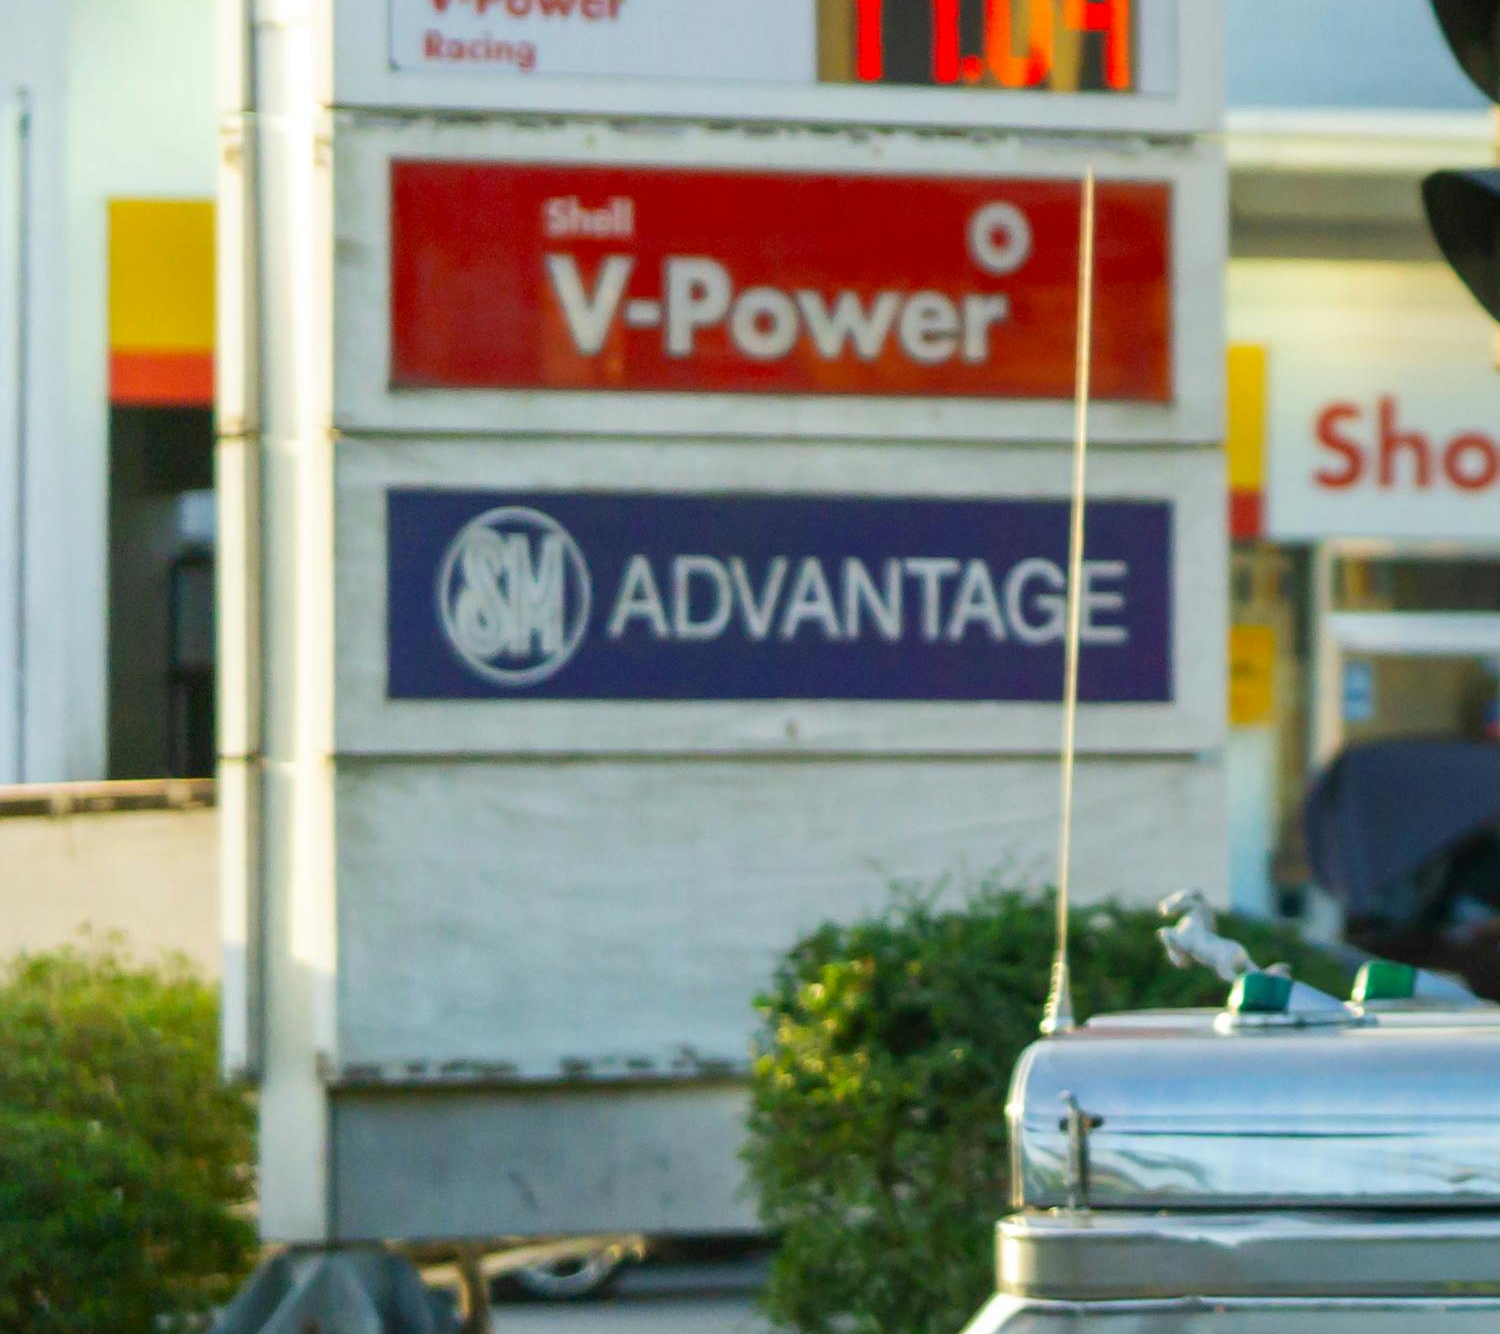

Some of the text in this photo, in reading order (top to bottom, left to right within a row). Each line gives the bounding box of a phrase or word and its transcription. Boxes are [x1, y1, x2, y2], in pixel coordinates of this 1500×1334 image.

[423, 31, 535, 69] Racing
[544, 198, 633, 237] Shell
[546, 256, 1006, 362] V-Power
[610, 555, 1128, 643] ADVANTAGE
